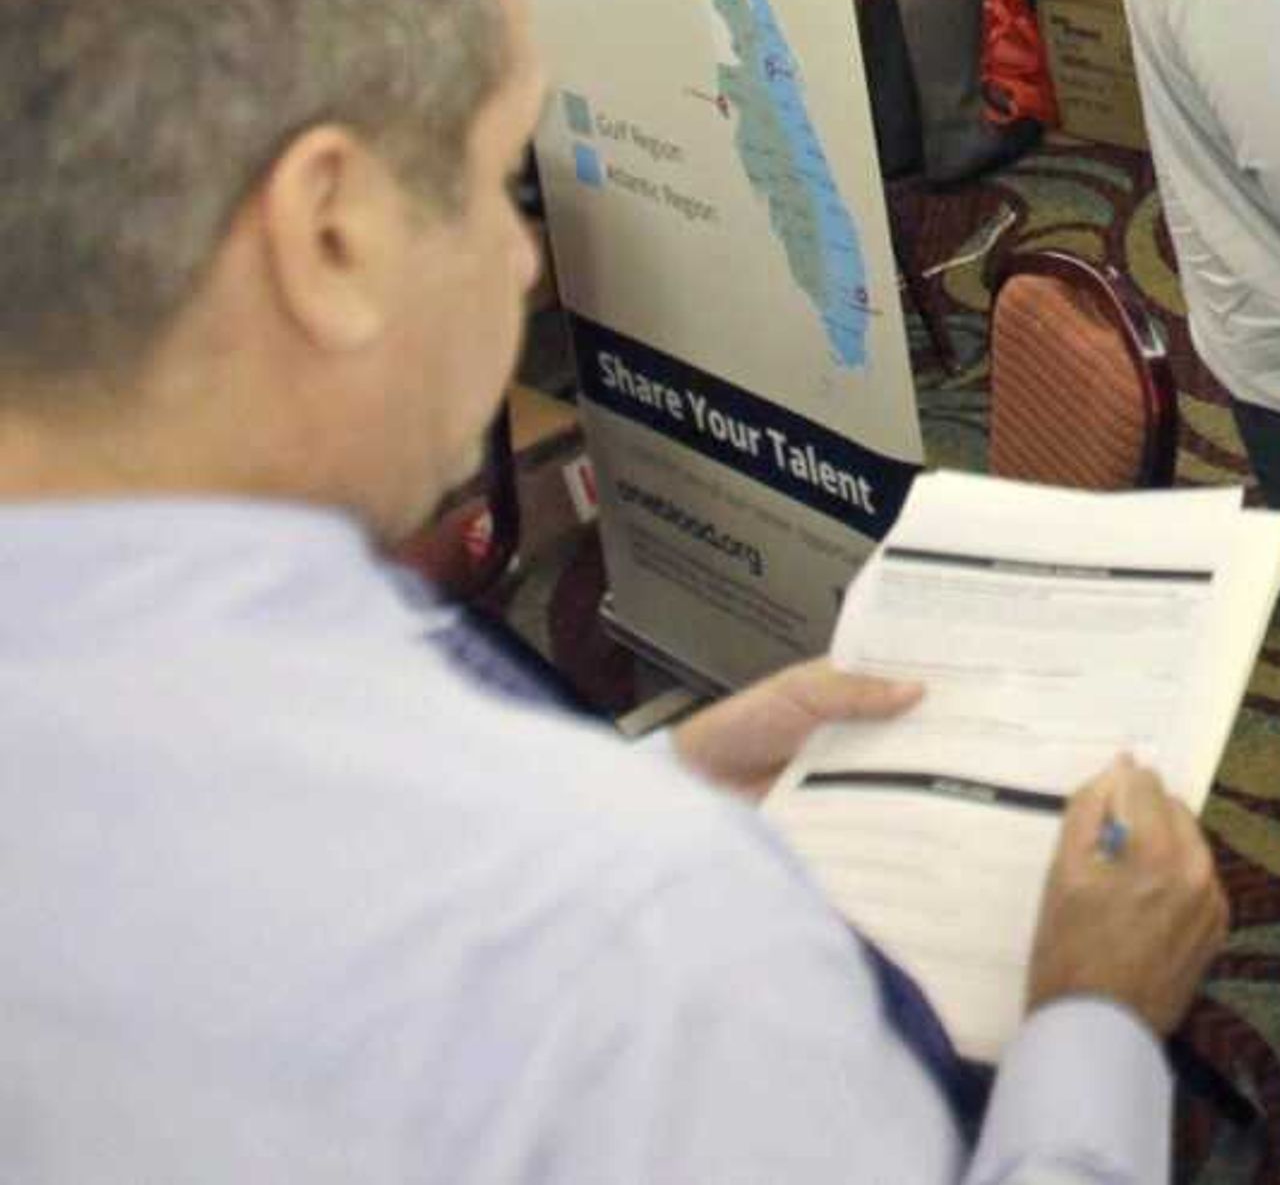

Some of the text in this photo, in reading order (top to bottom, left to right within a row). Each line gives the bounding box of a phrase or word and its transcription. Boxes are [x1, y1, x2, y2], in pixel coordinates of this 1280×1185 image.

[597, 351, 686, 421] Share
[687, 390, 763, 457] Your
[766, 427, 877, 515] Talent
